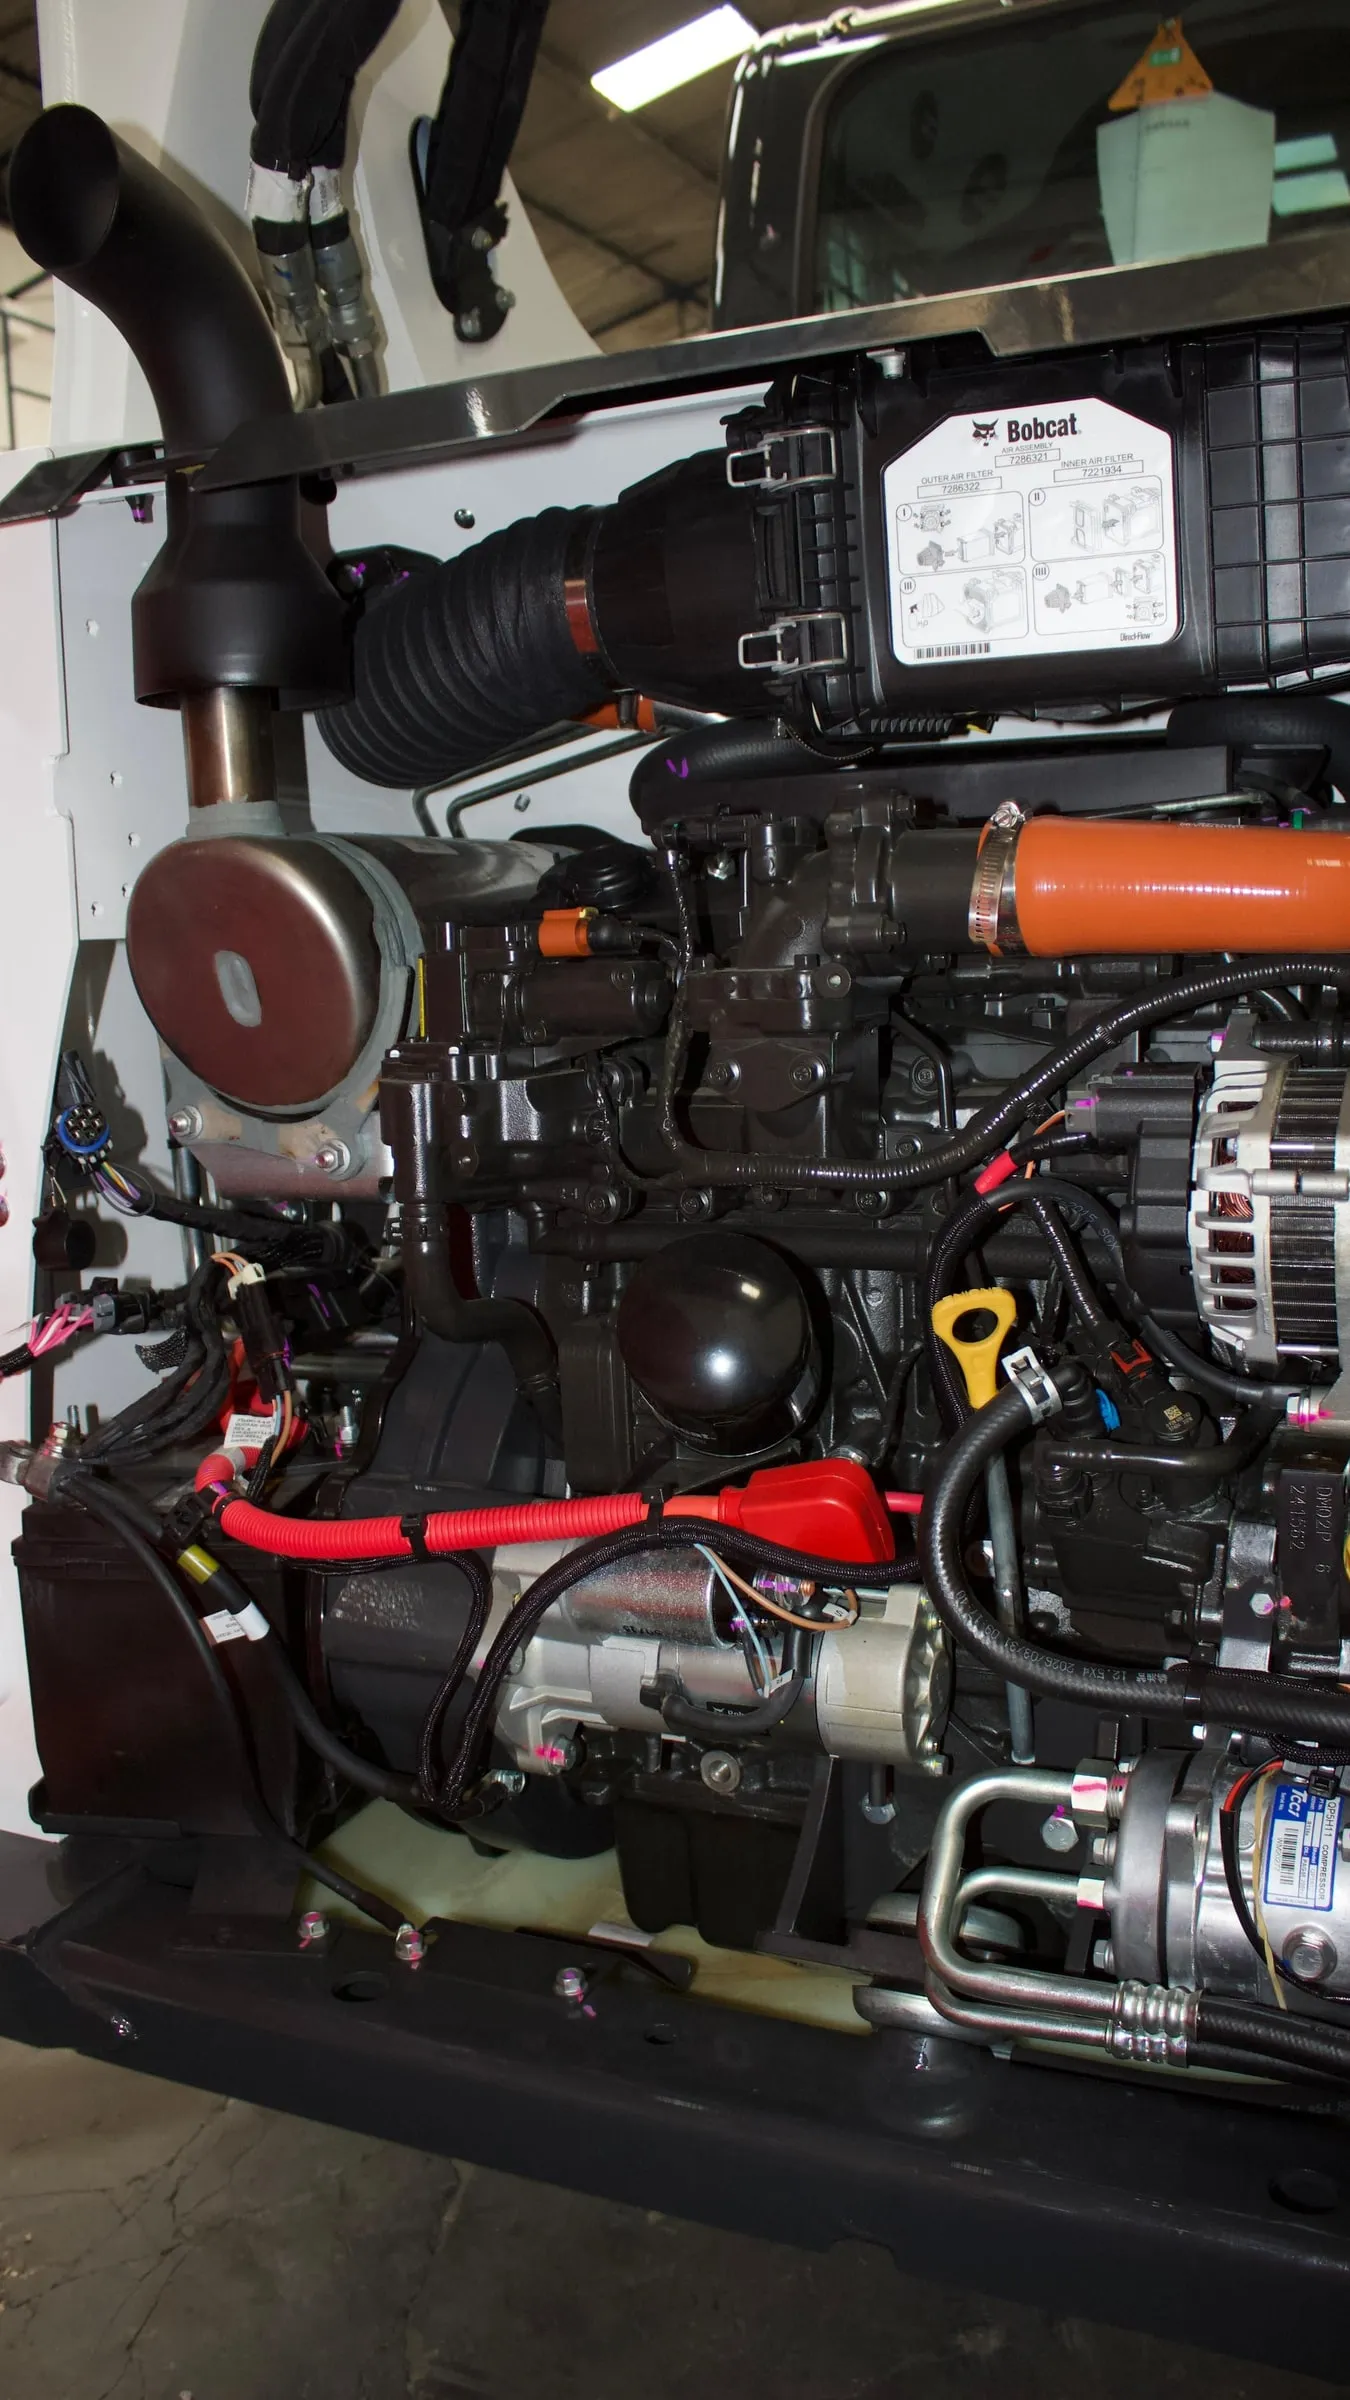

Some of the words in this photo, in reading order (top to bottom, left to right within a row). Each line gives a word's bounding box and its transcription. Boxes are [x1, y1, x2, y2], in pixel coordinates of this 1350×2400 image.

[1007, 413, 1078, 443] Bobcat
[1001, 446, 1014, 454] AIR
[1015, 442, 1053, 452] ASSEMBLY
[1010, 452, 1048, 465] 7286321
[1061, 459, 1087, 468] INNER
[1088, 457, 1103, 465] AIR
[1105, 453, 1134, 463] FILTER
[921, 474, 949, 485] OUTER
[951, 473, 964, 481] AIR
[966, 469, 994, 479] FILTER
[1081, 465, 1122, 477] 7221934
[942, 482, 980, 494] 7286322
[1324, 1801, 1337, 1838] QP5H11
[1318, 1845, 1329, 1900] COMPRESSOR
